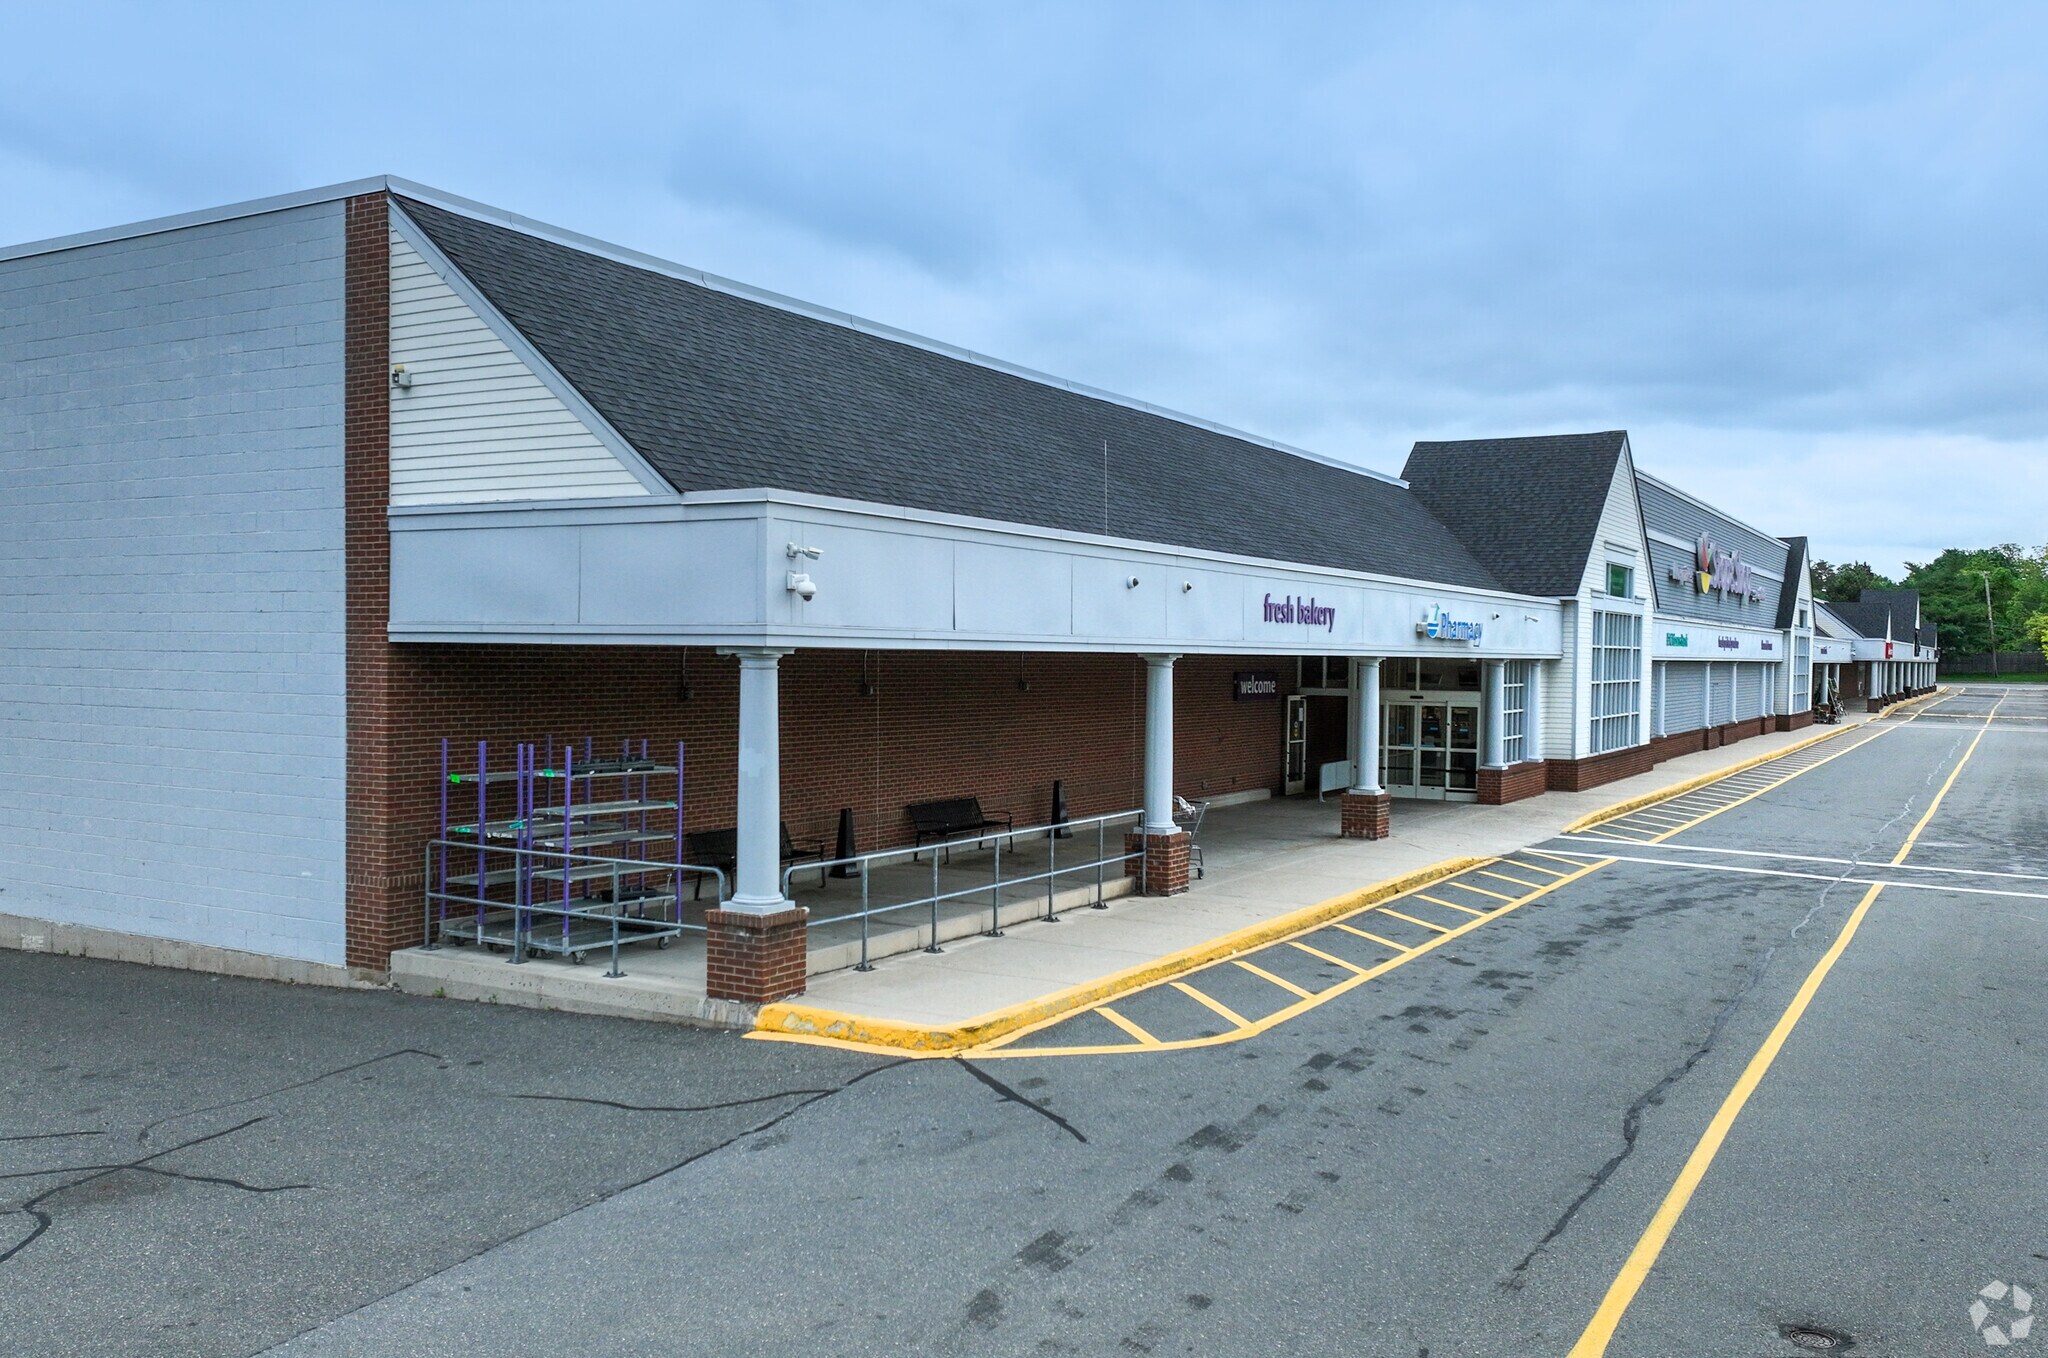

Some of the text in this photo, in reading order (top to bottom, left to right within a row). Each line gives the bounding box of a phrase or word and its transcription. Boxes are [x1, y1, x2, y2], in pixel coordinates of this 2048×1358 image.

[1264, 593, 1335, 633] fresh bakery
[1441, 612, 1483, 647] Pharmacy
[1240, 675, 1276, 694] welcome
